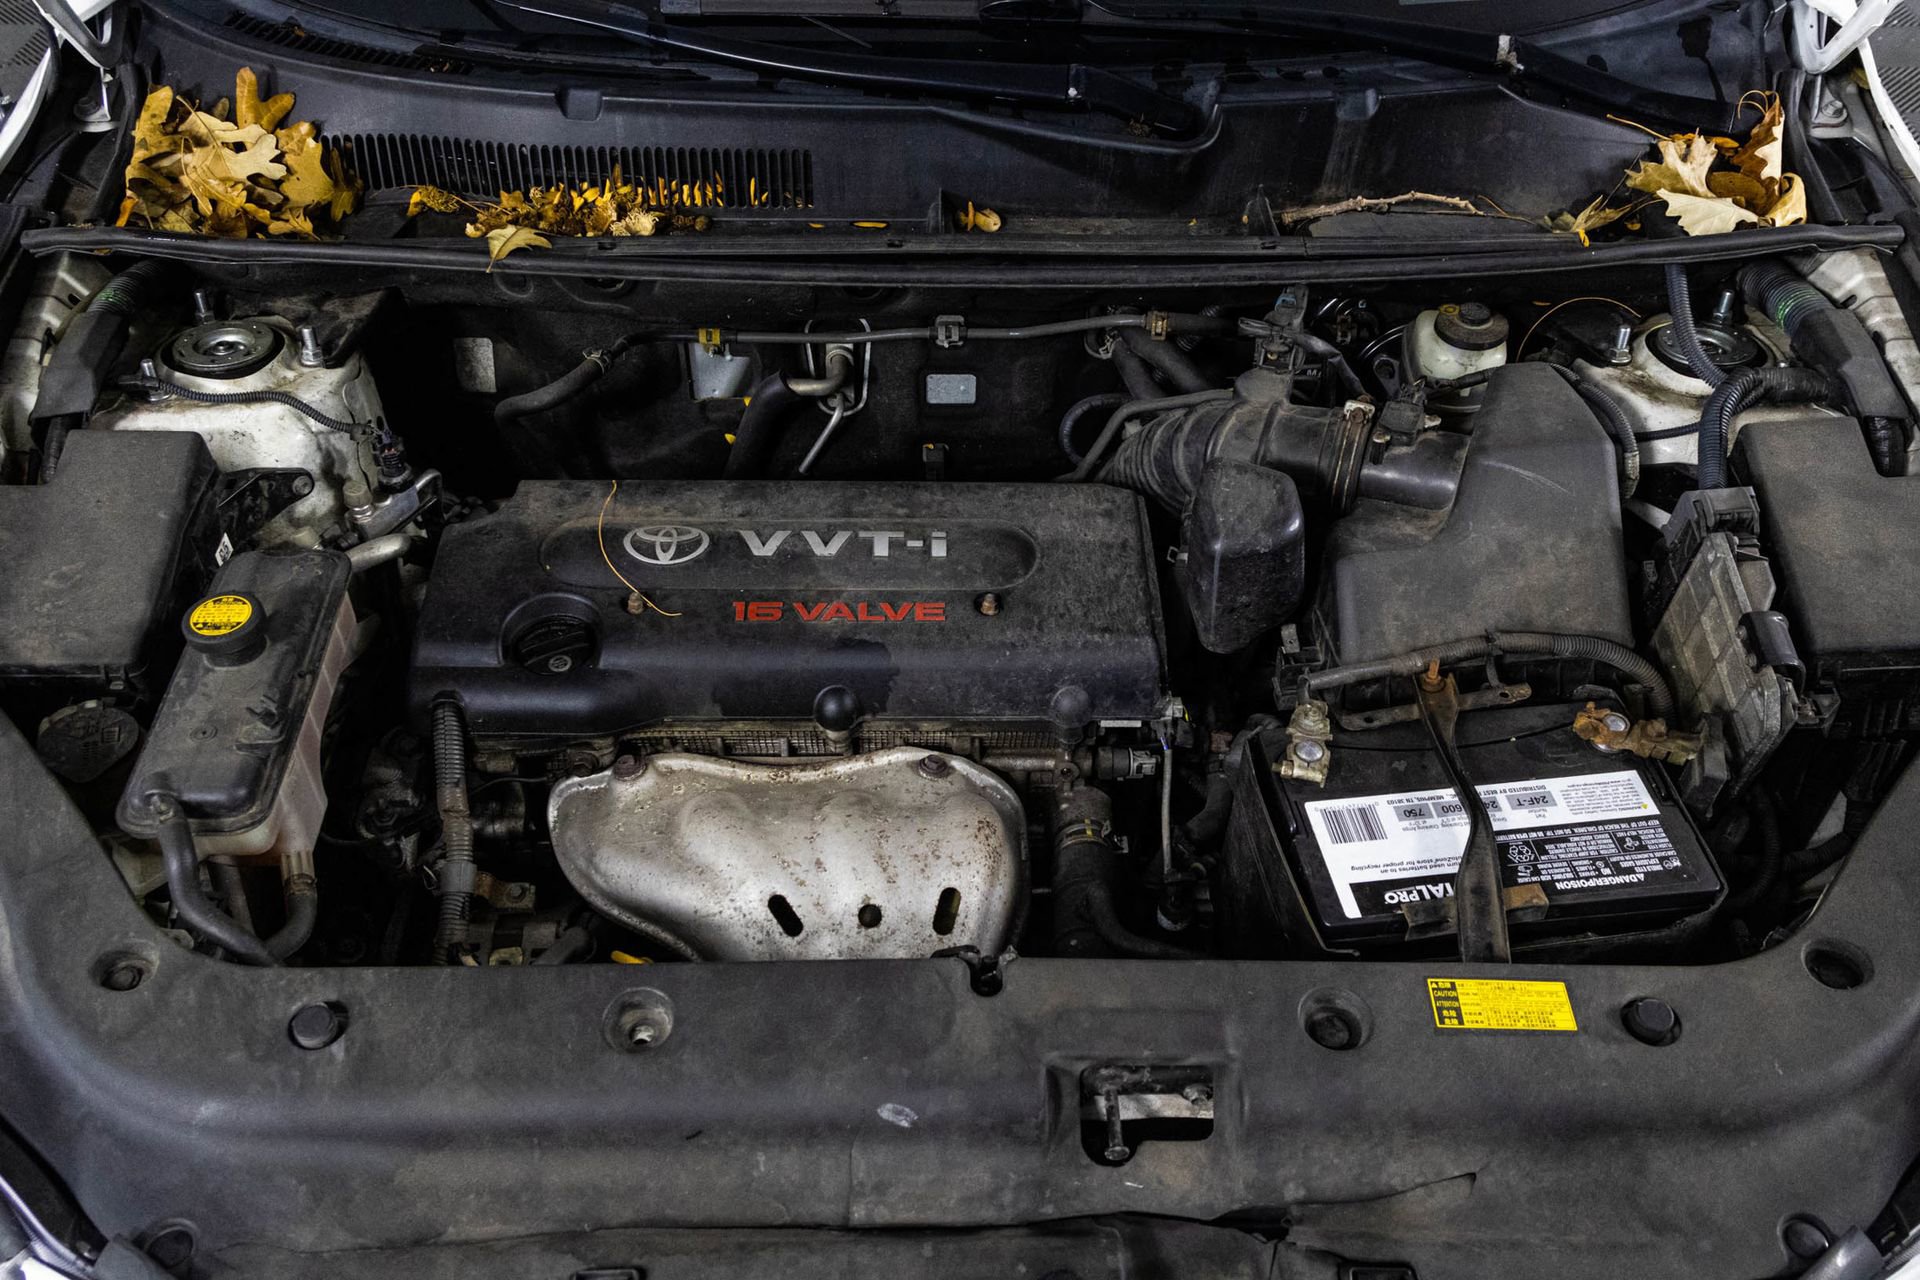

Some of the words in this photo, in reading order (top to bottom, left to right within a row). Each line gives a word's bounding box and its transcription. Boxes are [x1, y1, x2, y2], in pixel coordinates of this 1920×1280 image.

[739, 529, 948, 557] VVT-i
[732, 600, 783, 621] 16
[793, 600, 946, 622] VALVE
[1507, 784, 1546, 793] DISTRIBUTED
[1484, 800, 1498, 809] 24
[1516, 795, 1548, 806] 24F-T
[1403, 808, 1425, 818] 750
[1441, 804, 1462, 814] 600
[1556, 874, 1638, 889] DANGER/POISON
[1384, 882, 1454, 904] TALPRO
